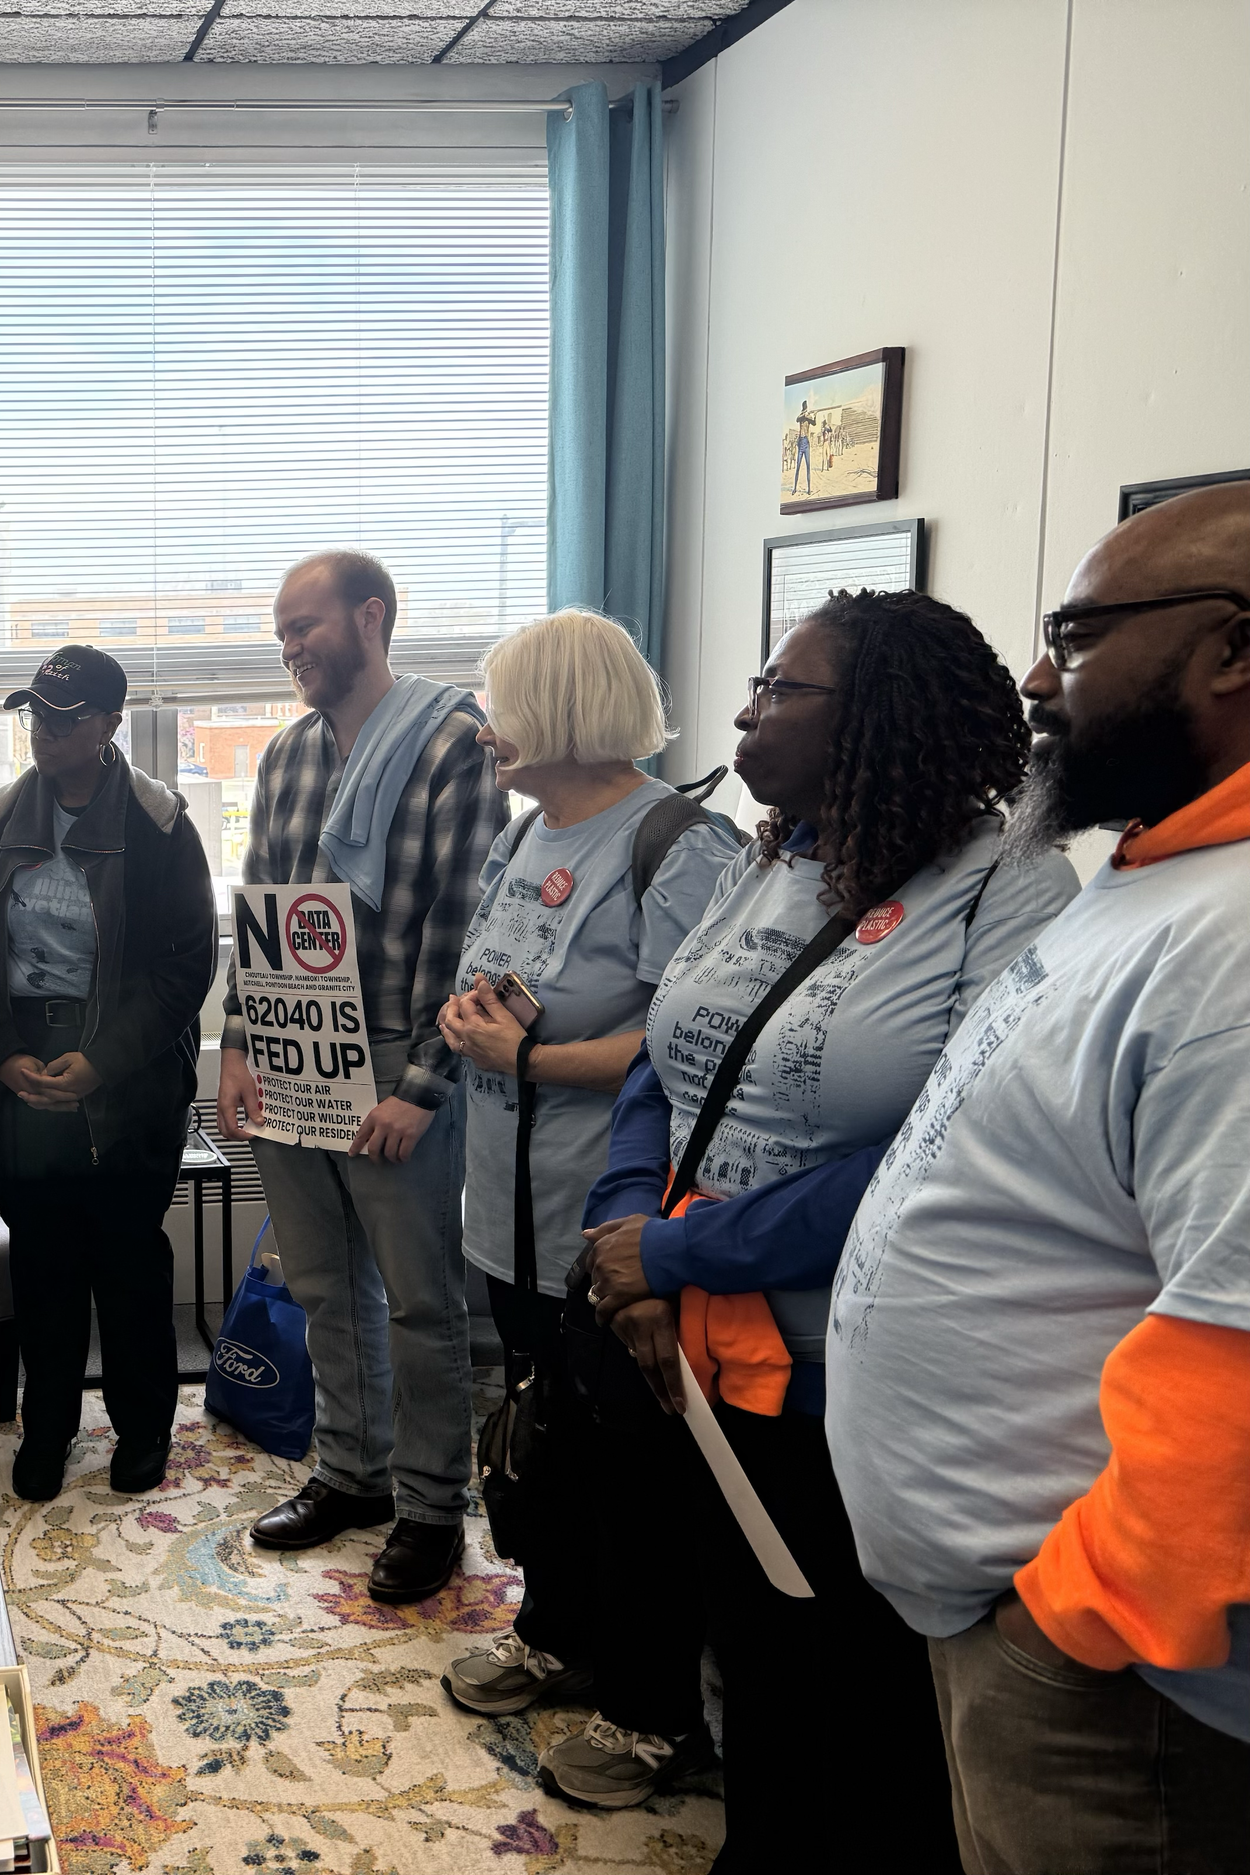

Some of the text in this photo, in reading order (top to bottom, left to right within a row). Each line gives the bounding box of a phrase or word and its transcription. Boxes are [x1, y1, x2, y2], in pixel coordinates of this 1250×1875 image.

[544, 880, 561, 900] PLASTIC
[551, 872, 568, 891] REDUCE
[298, 910, 331, 929] DATA
[865, 907, 894, 918] REDUCE
[860, 920, 888, 930] PLASTIC
[480, 948, 511, 968] POWER
[245, 994, 360, 1034] 62040 IS
[692, 1006, 740, 1034] POW
[672, 1020, 727, 1055] belon
[250, 1033, 366, 1079] FED UP
[668, 1042, 696, 1066] the
[263, 1076, 331, 1095] PROTECT OUR AIR
[681, 1070, 709, 1089] not
[265, 1089, 352, 1111] PROTECT OUR WATER
[265, 1103, 361, 1126] PROTECT OUR WILDLIFE
[264, 1117, 295, 1134] PROTECT
[297, 1125, 316, 1137] OUR
[217, 1342, 264, 1384] Ford
